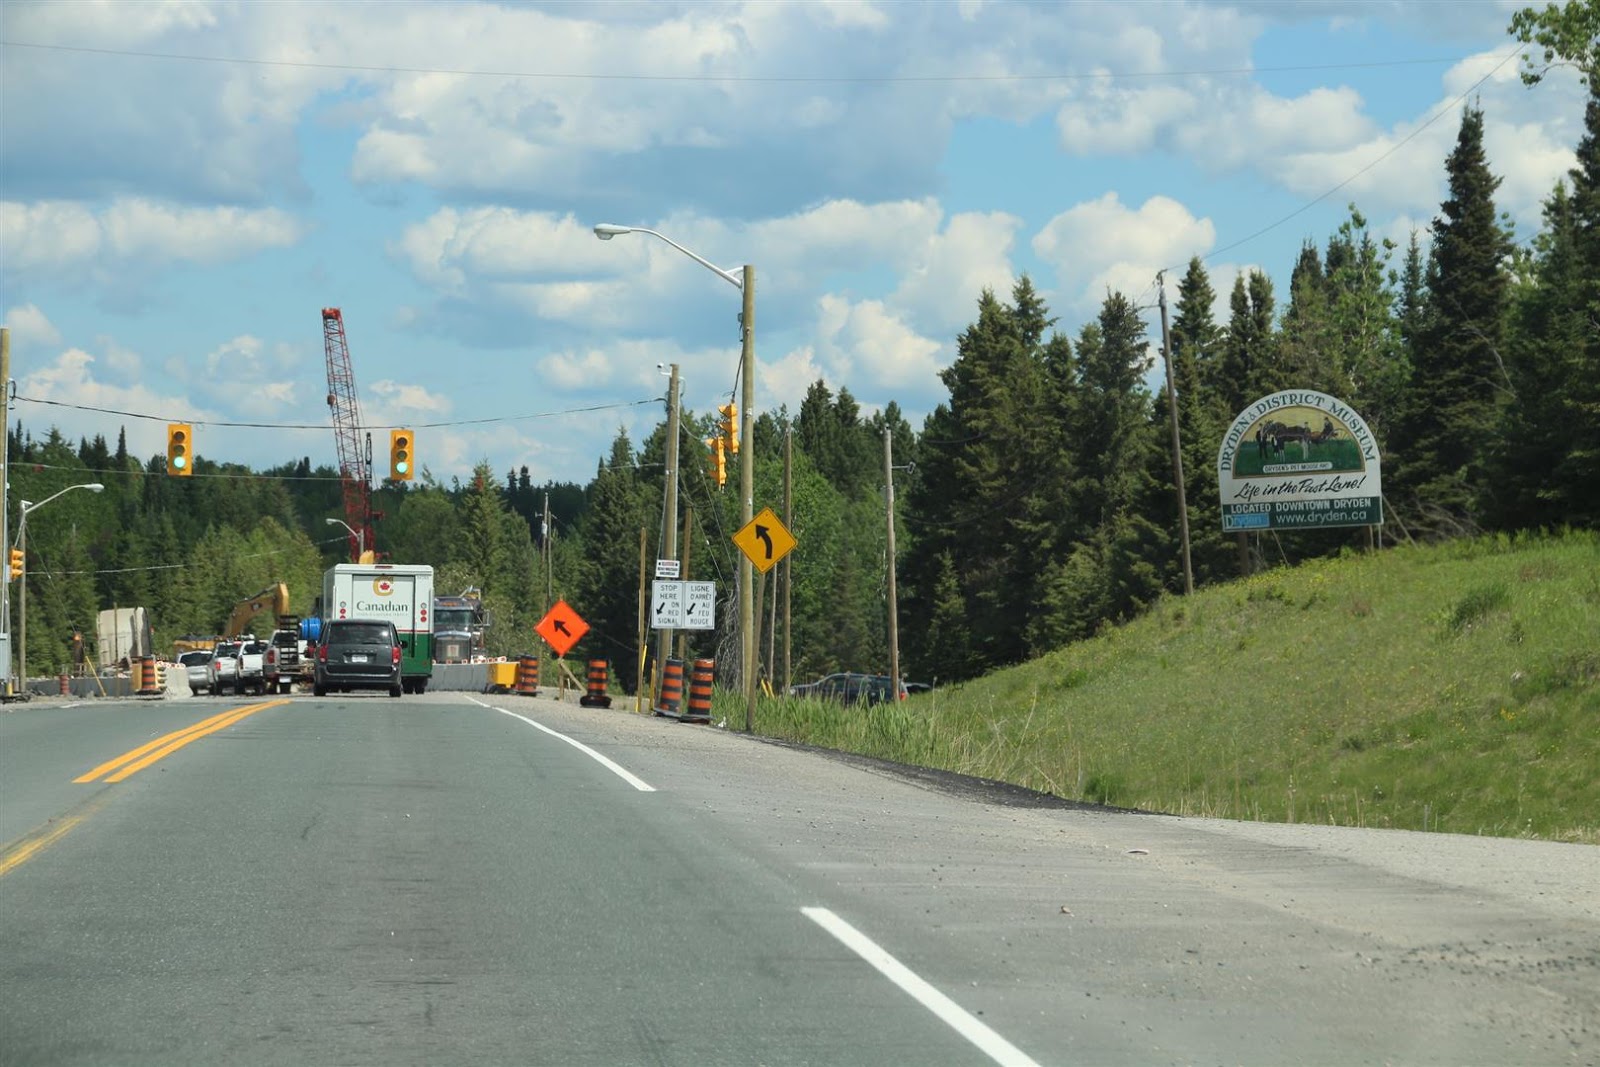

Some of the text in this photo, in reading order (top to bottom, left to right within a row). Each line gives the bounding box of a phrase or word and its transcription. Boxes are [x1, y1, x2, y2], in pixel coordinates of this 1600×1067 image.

[1221, 416, 1250, 471] DRYDEN
[1255, 393, 1325, 417] DISTRICT
[1329, 402, 1376, 461] MUSEUM
[1234, 475, 1367, 502] Life in the Past Lane!
[1231, 498, 1371, 514] LOCATED DOWNTOWN DRYDEN
[1276, 510, 1367, 525] www.dryden.ca
[356, 600, 409, 612] Canadian
